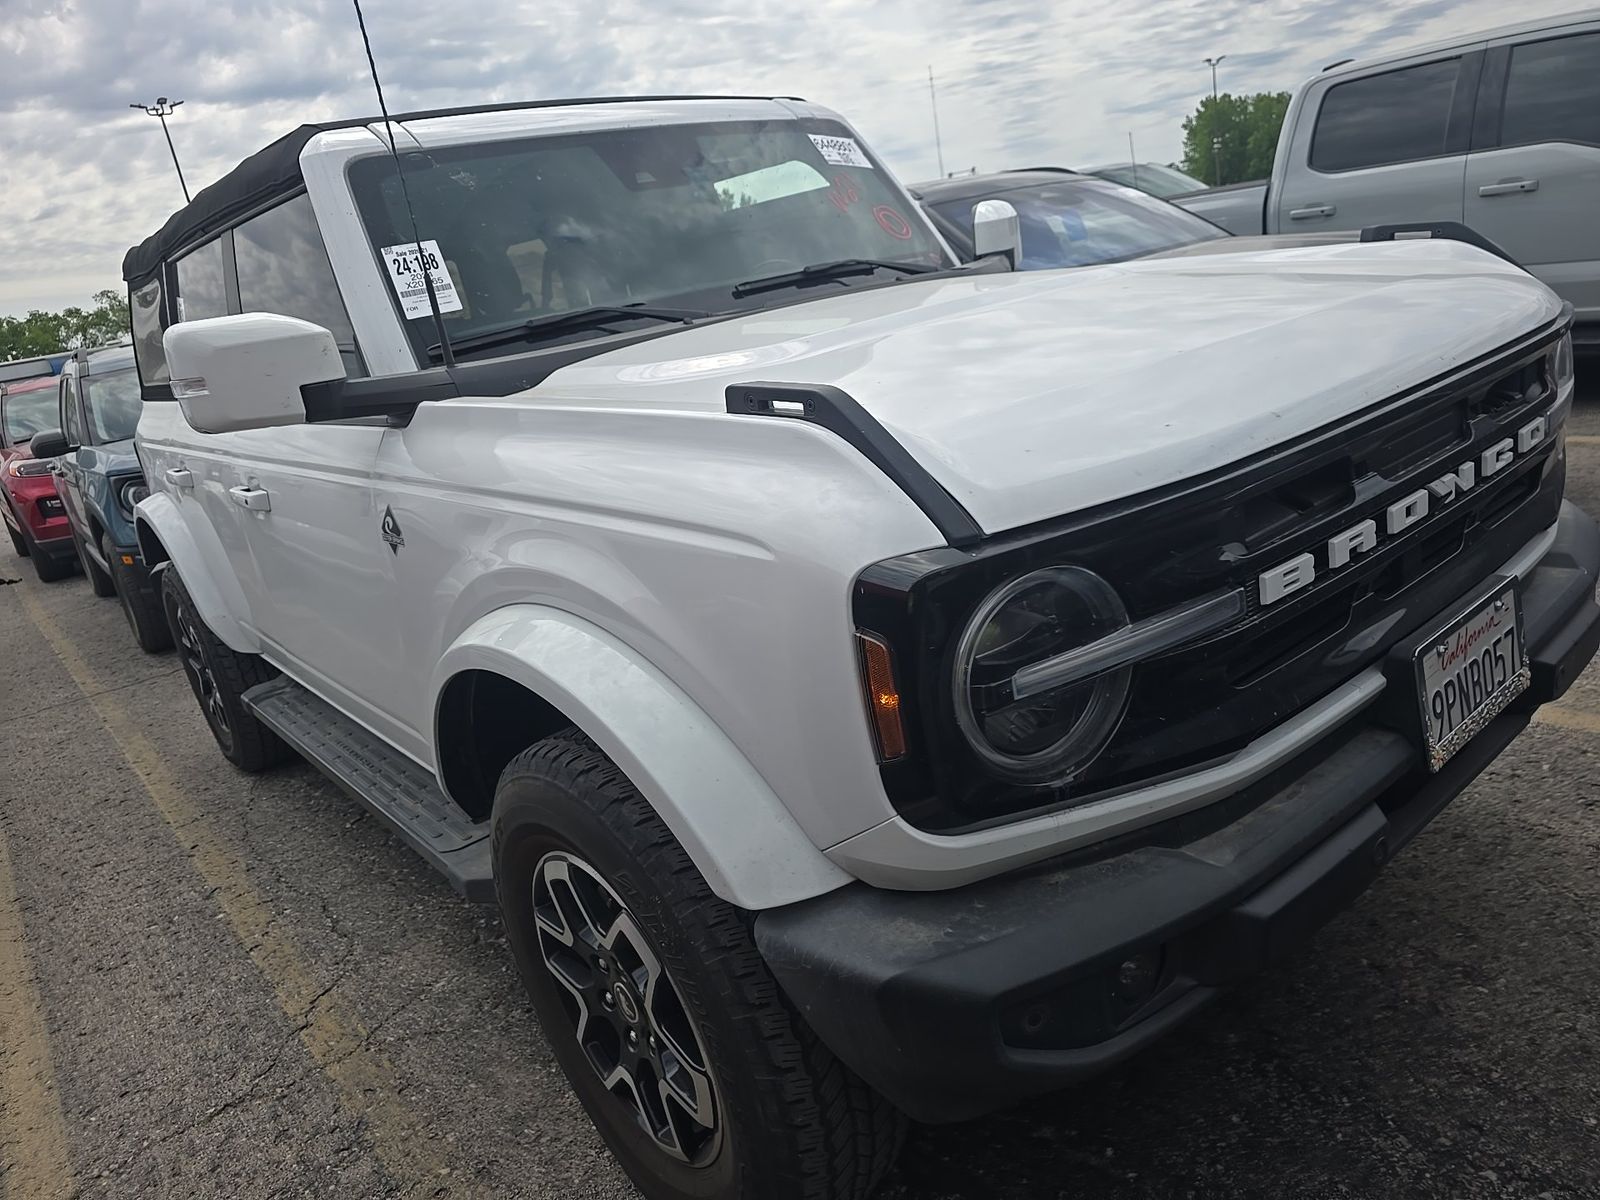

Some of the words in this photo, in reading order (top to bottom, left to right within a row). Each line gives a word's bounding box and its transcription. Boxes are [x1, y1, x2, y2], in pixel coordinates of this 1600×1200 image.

[410, 271, 434, 281] 201
[1258, 416, 1546, 605] BRONCO
[1432, 626, 1517, 743] 9PNB057
[1441, 612, 1501, 671] California
